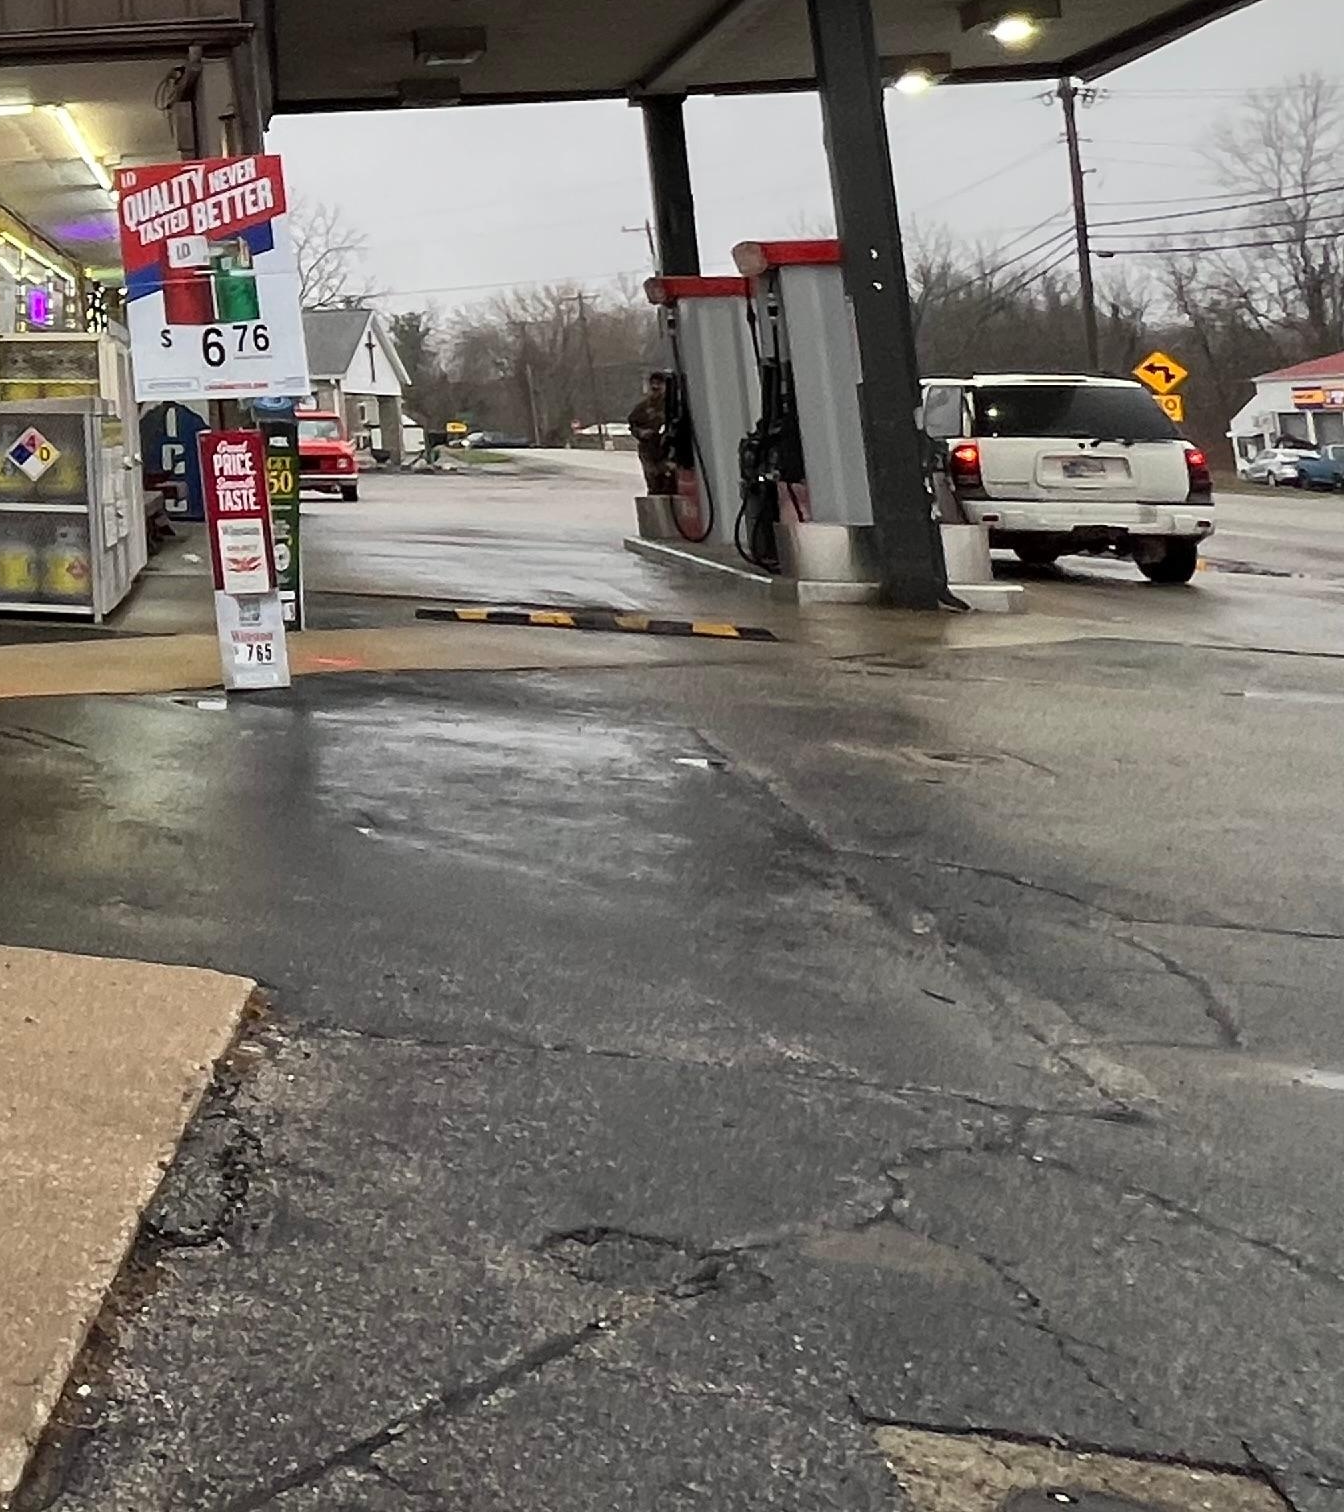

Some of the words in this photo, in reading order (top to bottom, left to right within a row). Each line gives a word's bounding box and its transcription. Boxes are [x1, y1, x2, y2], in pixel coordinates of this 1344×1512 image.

[122, 164, 206, 233] QUALITY
[208, 157, 257, 194] NEVER
[137, 208, 190, 246] TASTED
[191, 176, 275, 235] BETTER
